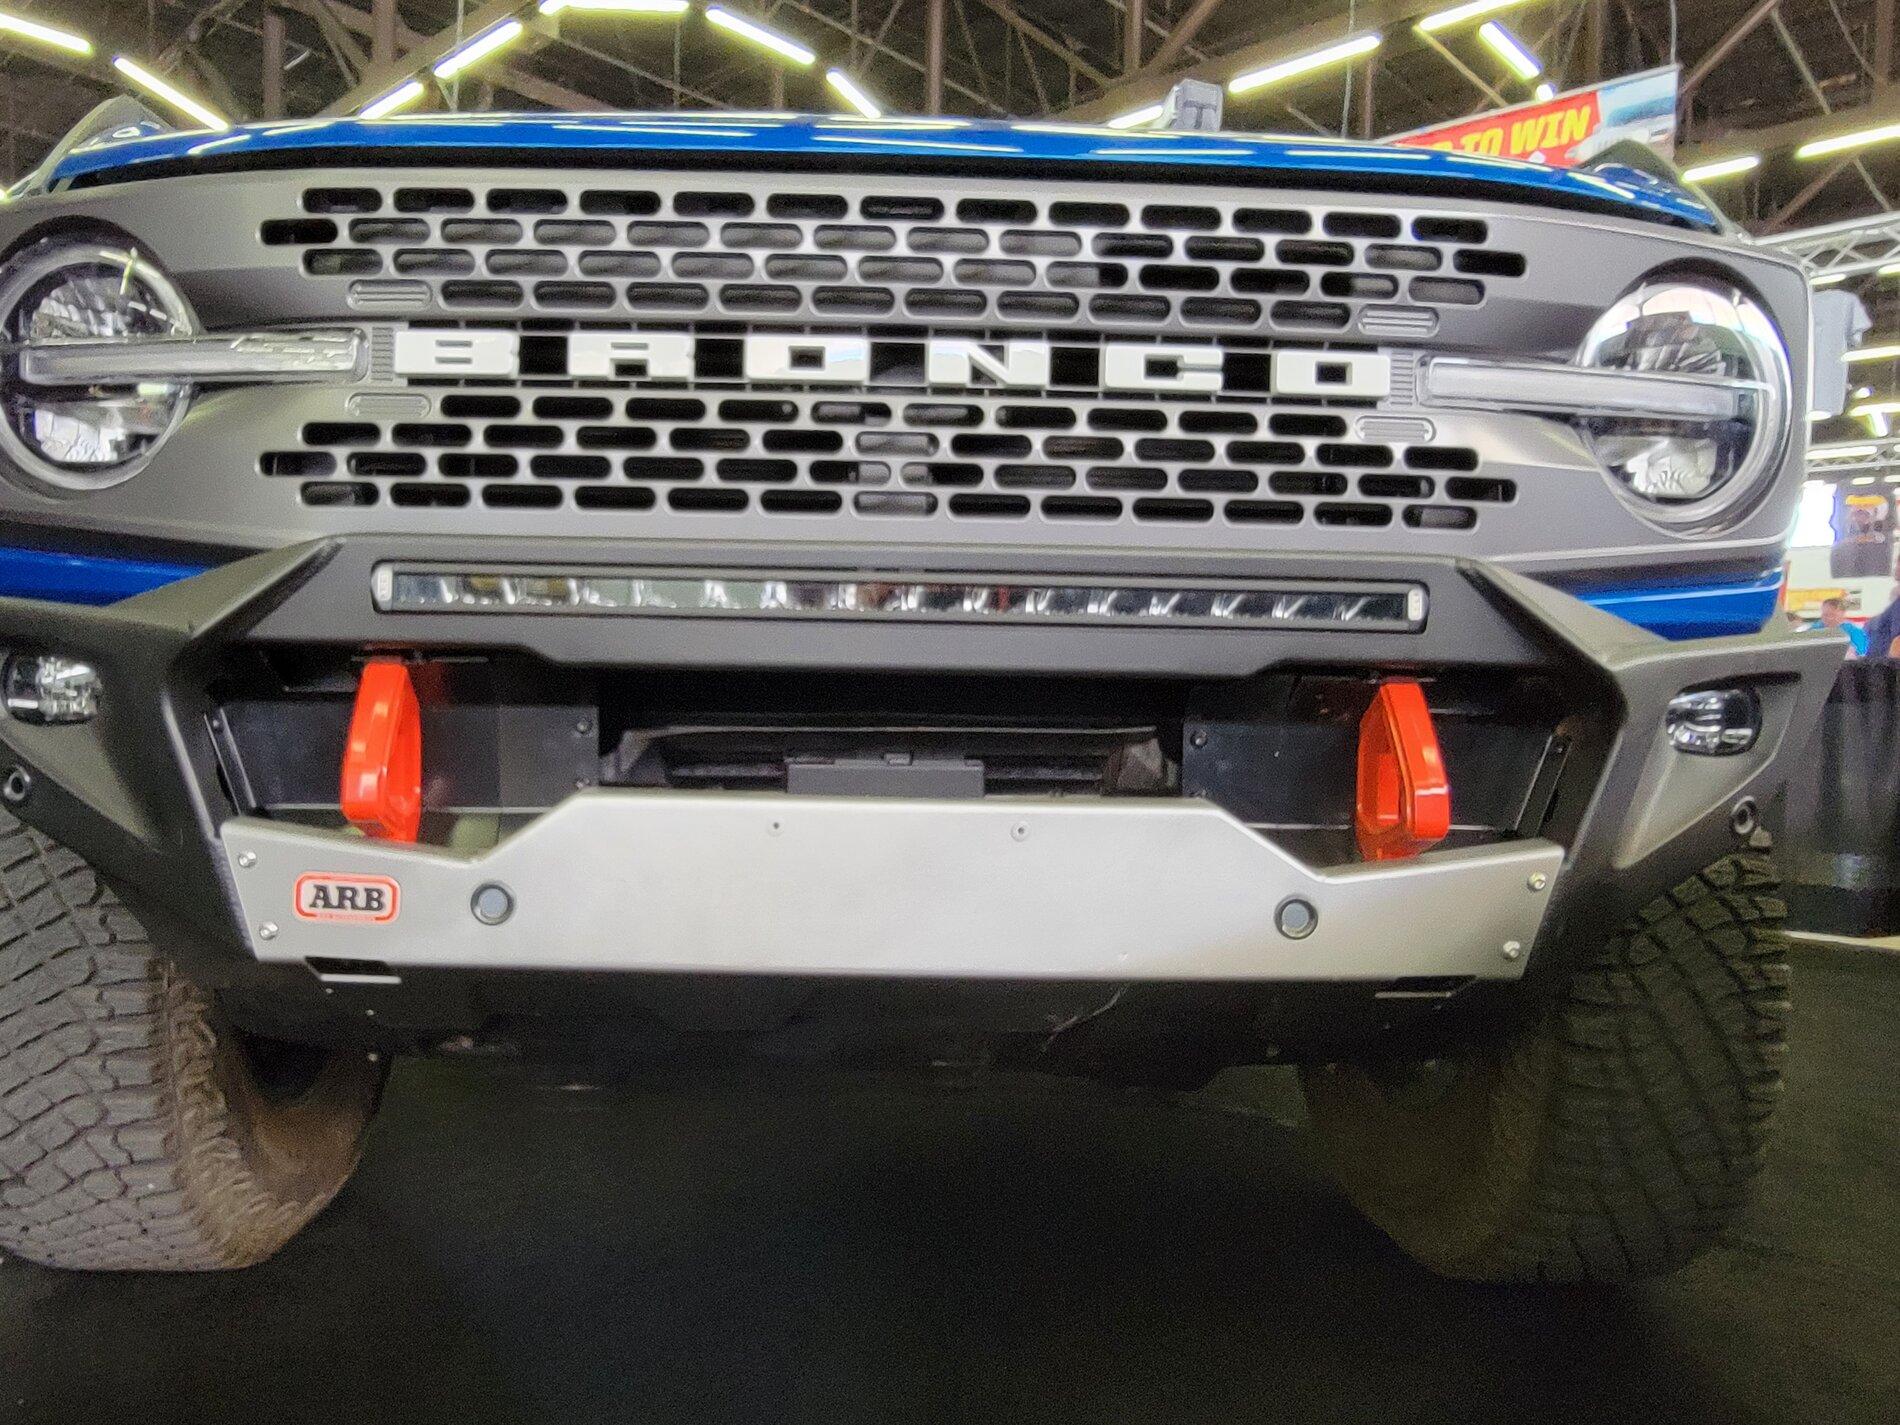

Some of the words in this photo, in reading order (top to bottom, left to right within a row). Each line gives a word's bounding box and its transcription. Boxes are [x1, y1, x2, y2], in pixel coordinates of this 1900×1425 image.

[1510, 105, 1591, 155] WIN
[394, 329, 1391, 397] BRONCO
[309, 885, 384, 911] ARB
